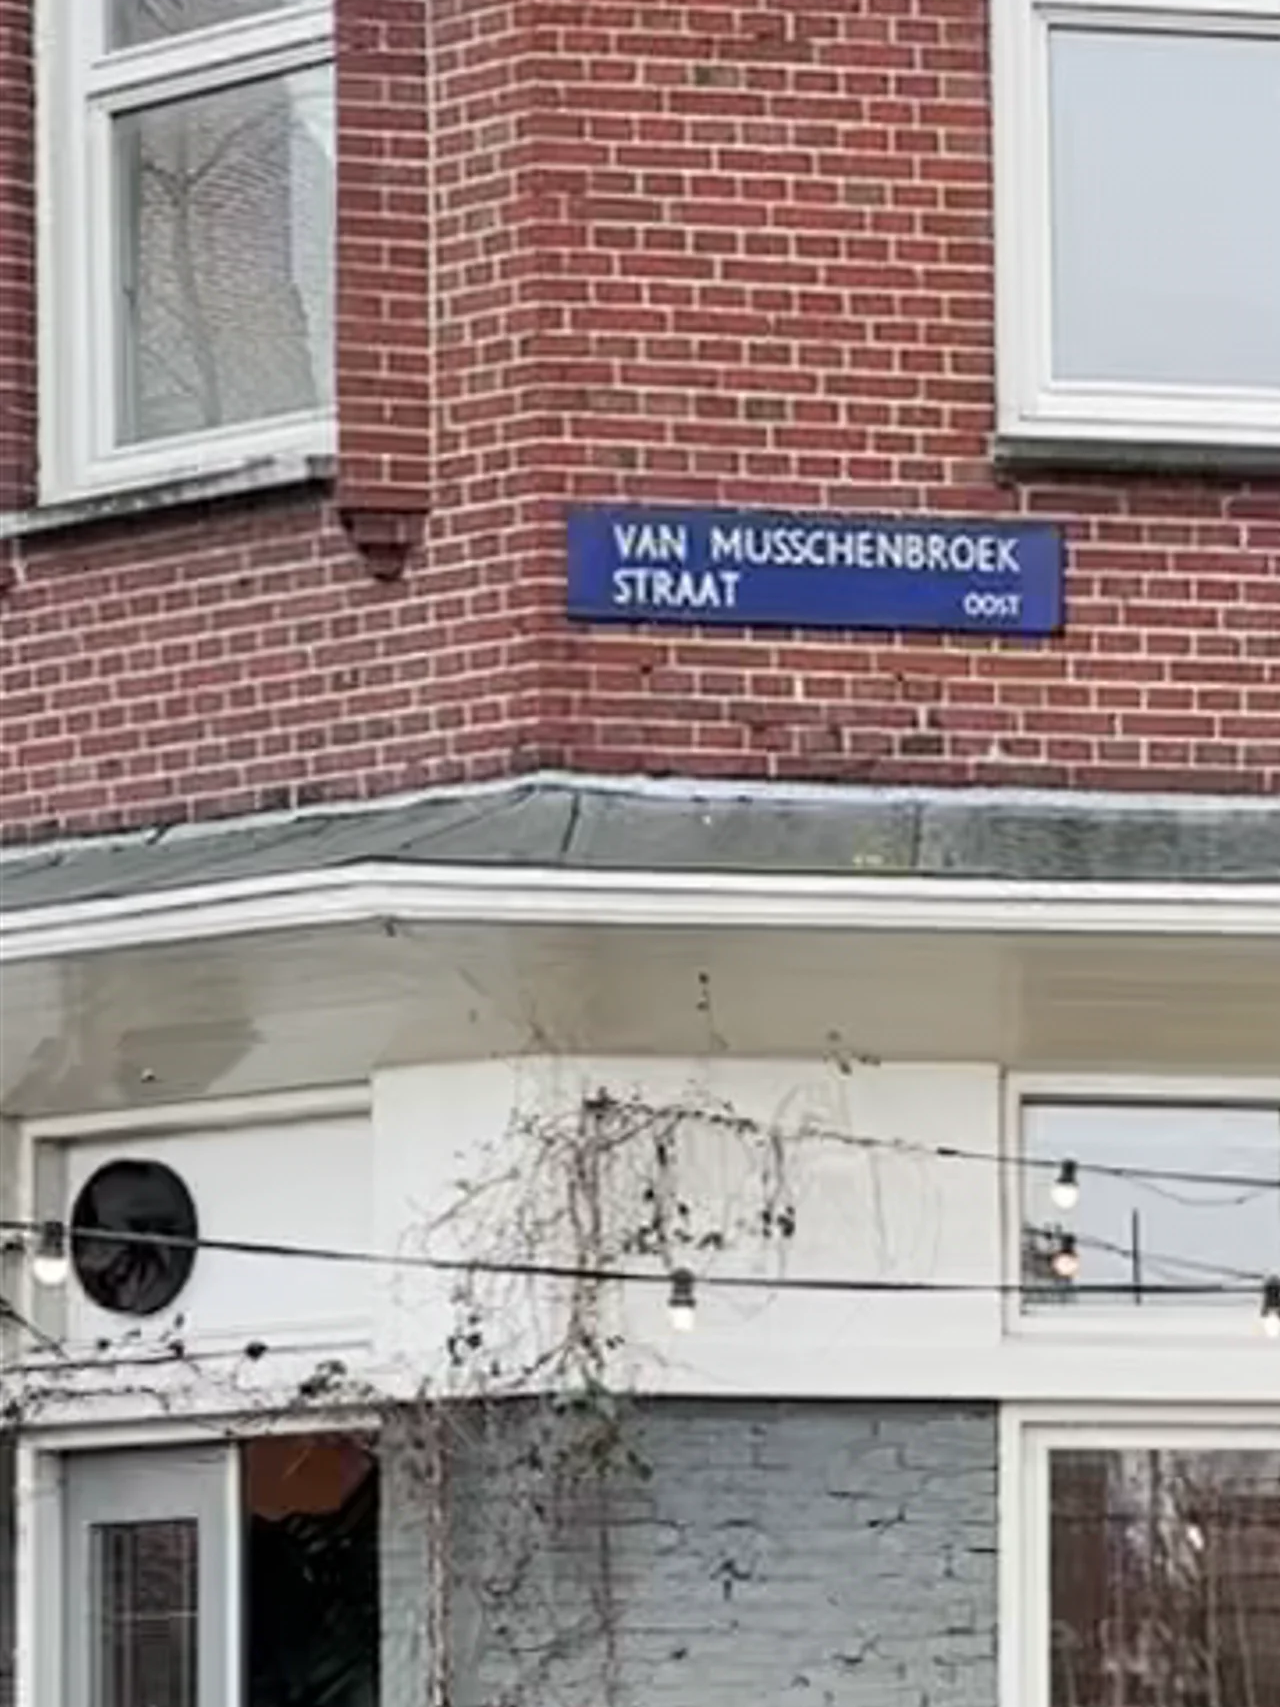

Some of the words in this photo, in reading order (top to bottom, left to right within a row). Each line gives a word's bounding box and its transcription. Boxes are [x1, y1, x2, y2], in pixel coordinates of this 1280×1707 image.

[613, 524, 686, 561] VAN
[711, 525, 1021, 573] MUSSCHENBROEK
[613, 568, 741, 608] STRAAT
[963, 592, 1021, 616] OOST
